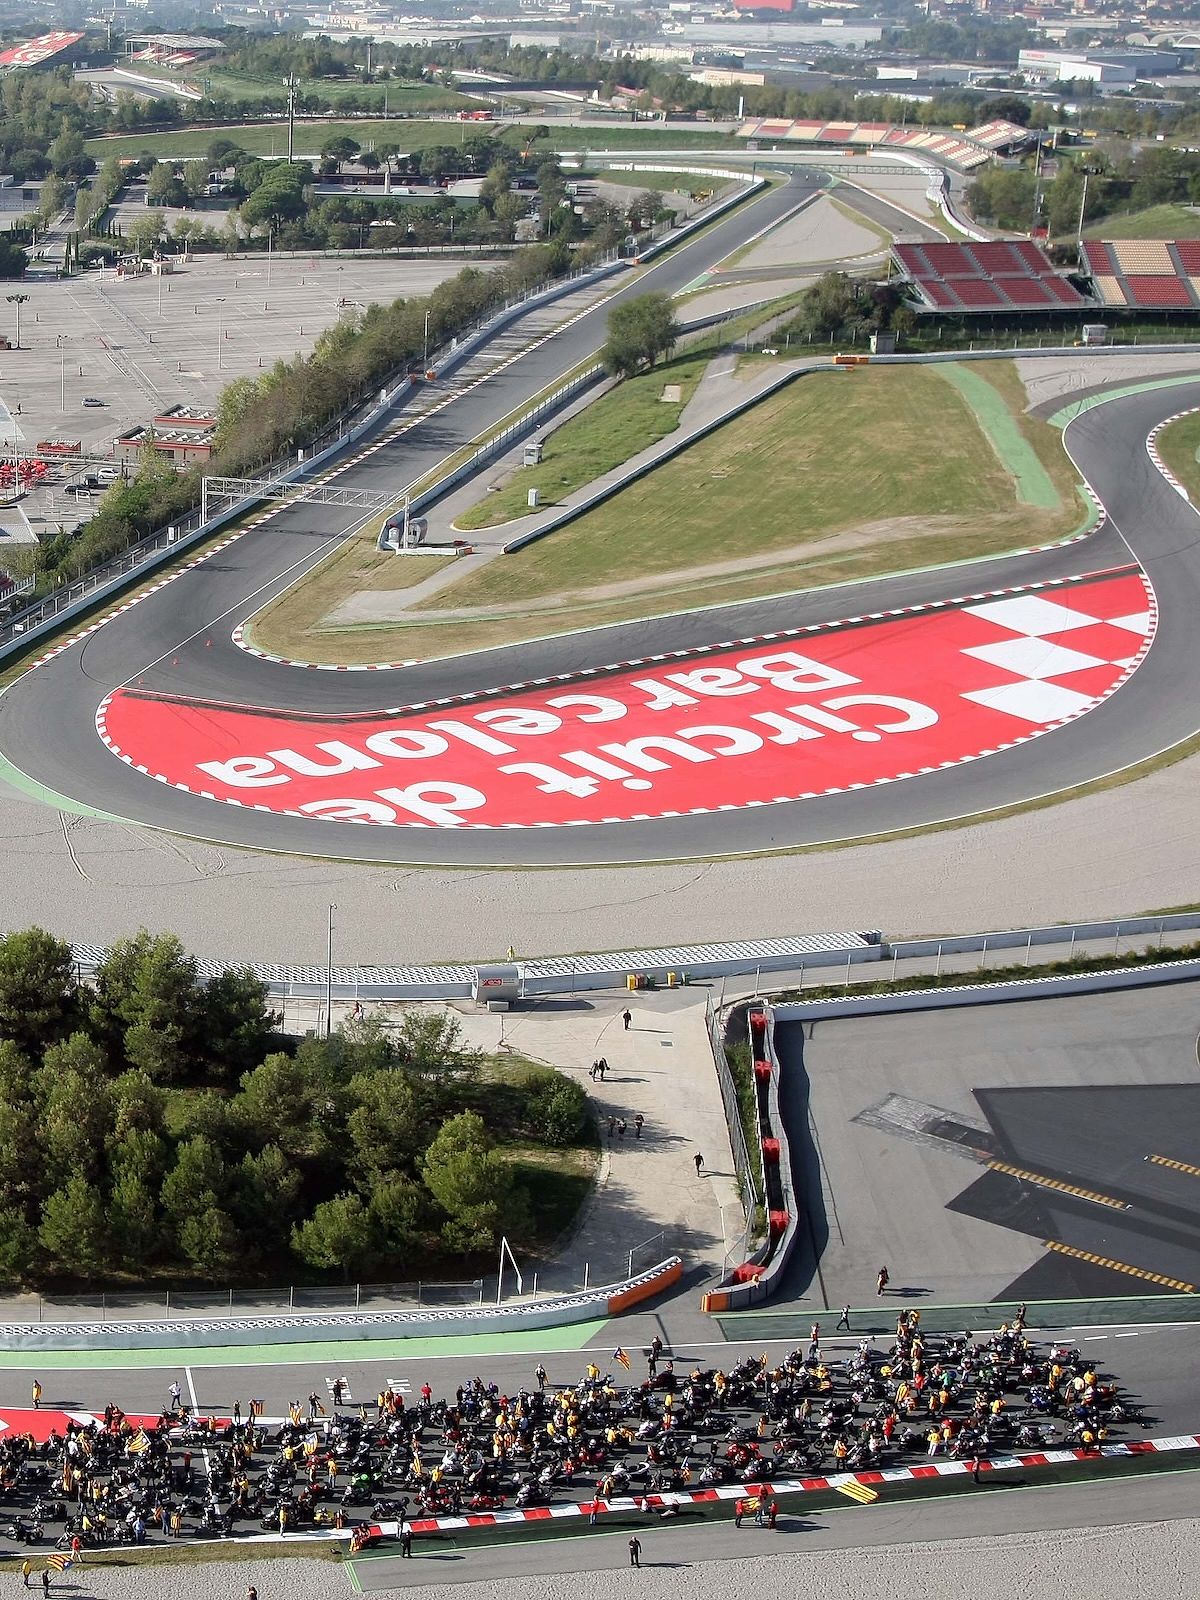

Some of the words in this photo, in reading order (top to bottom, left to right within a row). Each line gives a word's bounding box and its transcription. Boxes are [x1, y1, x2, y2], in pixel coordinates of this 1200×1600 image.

[195, 652, 862, 788] Barcelona
[497, 694, 938, 798] Circuit
[299, 781, 487, 826] de
[386, 1378, 412, 1393] PIT
